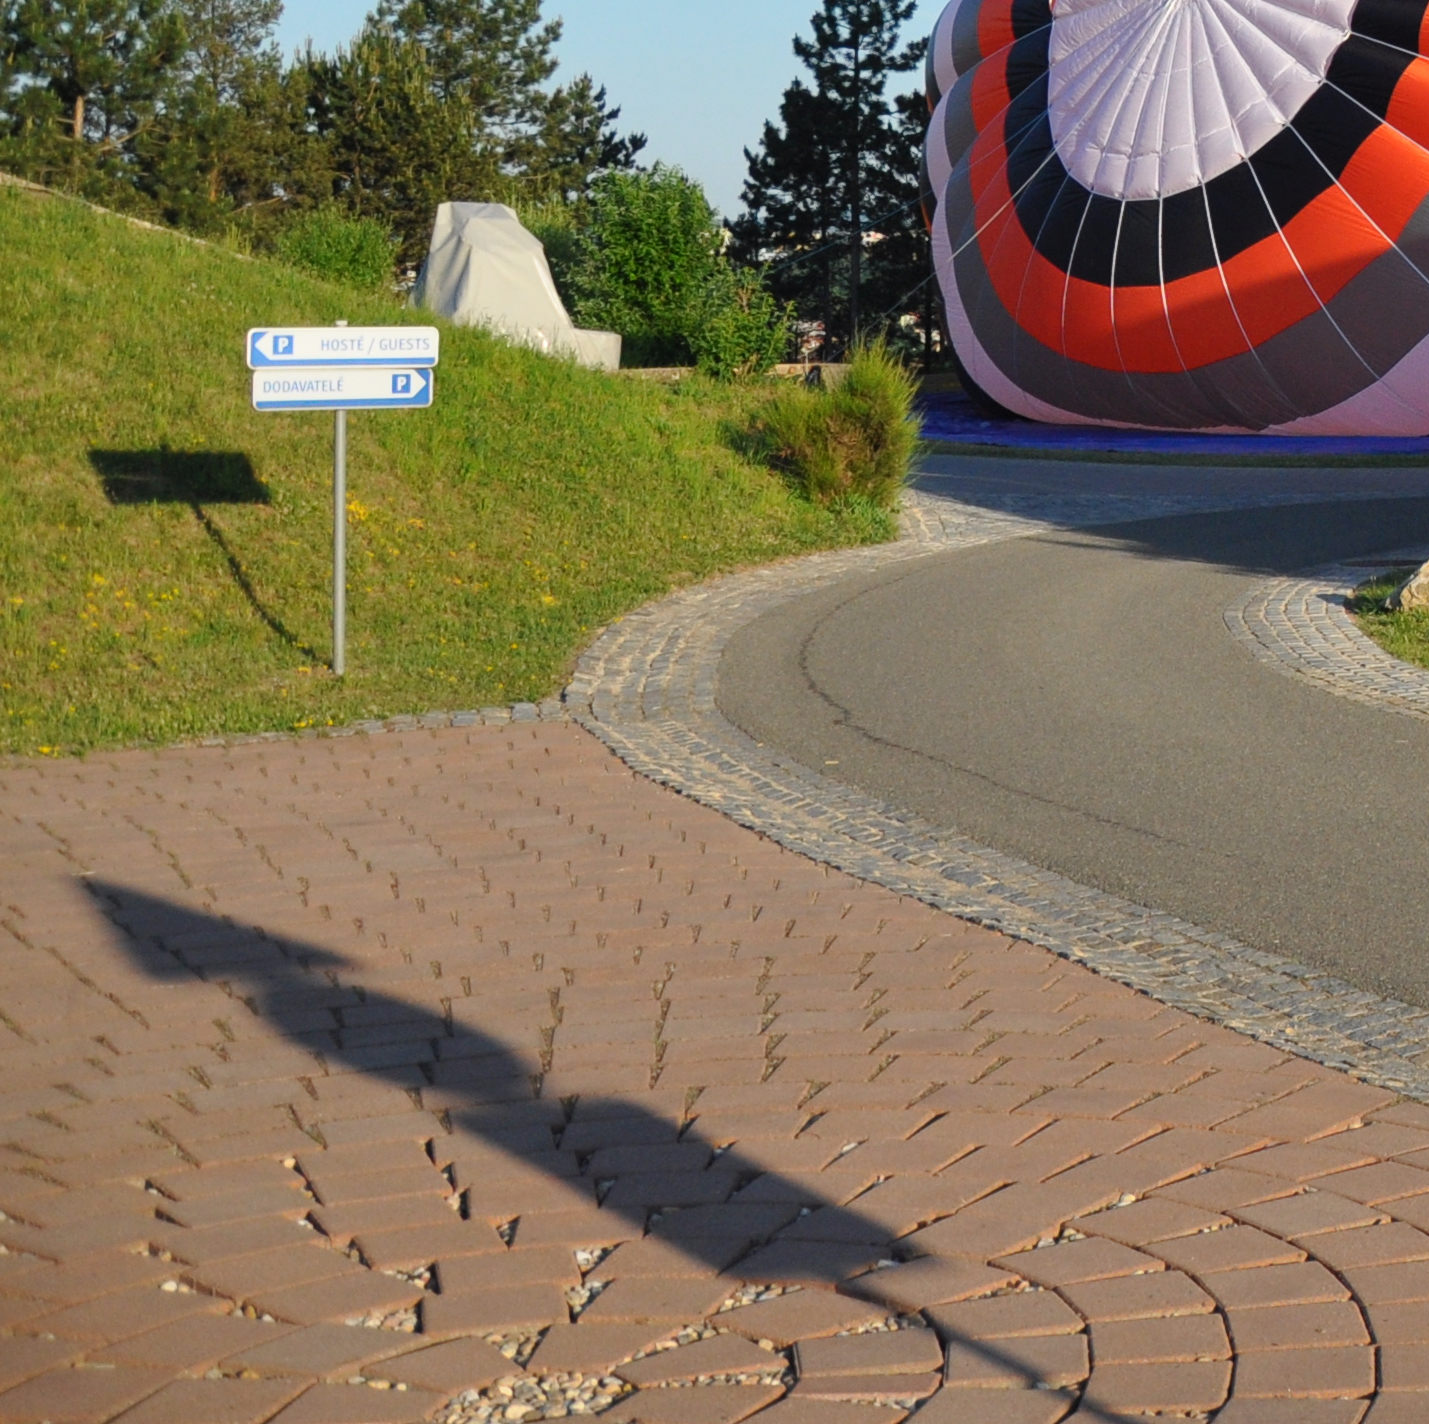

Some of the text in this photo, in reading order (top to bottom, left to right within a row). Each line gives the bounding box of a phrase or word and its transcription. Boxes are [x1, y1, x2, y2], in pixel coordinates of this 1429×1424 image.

[320, 336, 364, 352] HOSTÉ
[379, 337, 431, 351] GUESTS
[263, 376, 344, 393] DODAVATELÉ
